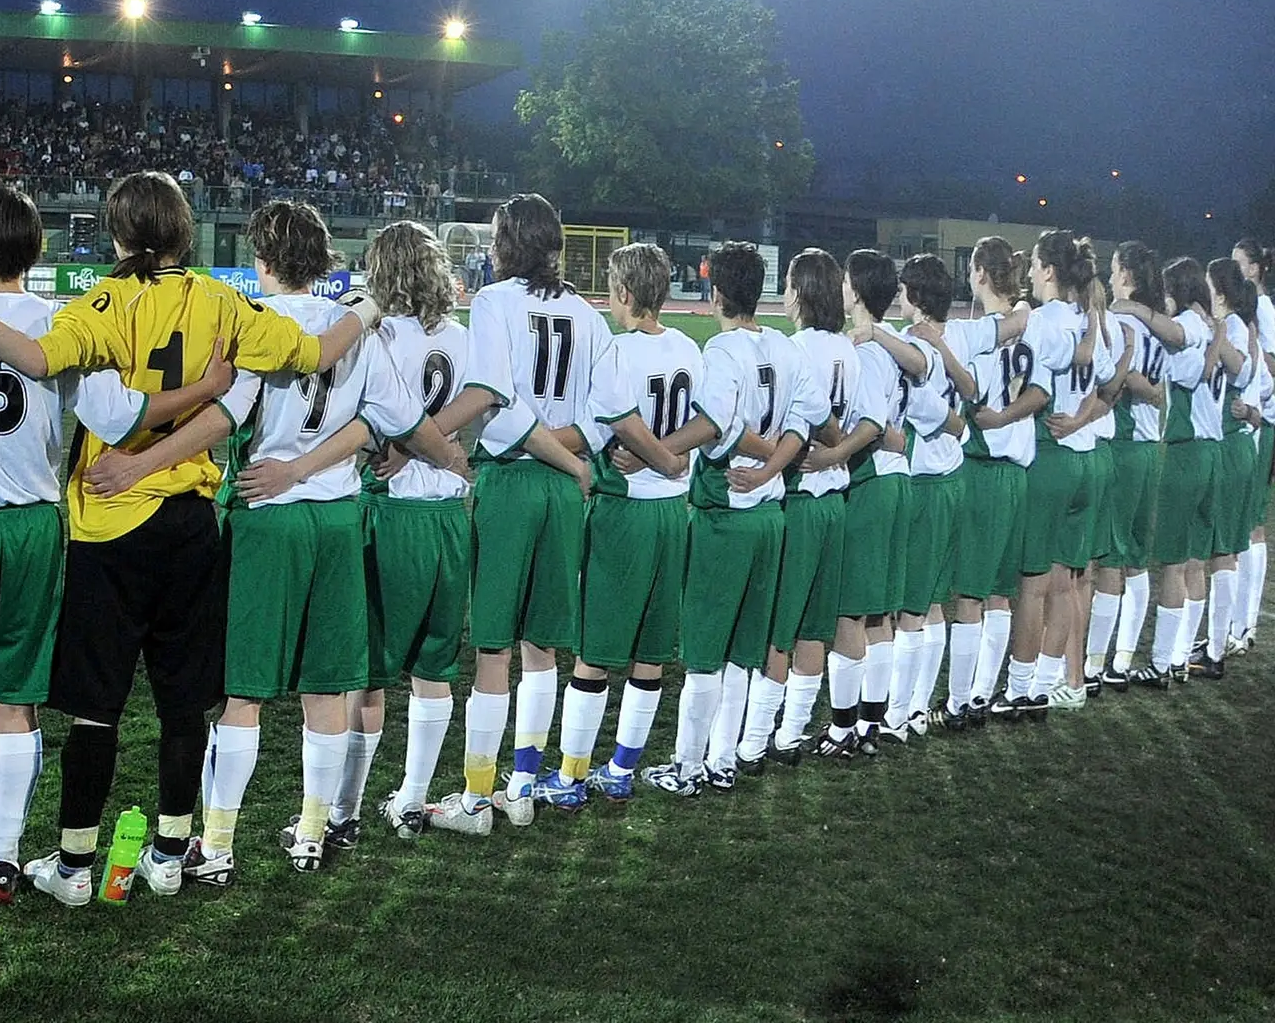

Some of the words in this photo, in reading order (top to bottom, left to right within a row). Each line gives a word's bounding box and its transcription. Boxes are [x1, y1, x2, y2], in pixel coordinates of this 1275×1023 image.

[147, 331, 184, 433] 1
[528, 311, 574, 401] 11
[647, 368, 693, 440] 10
